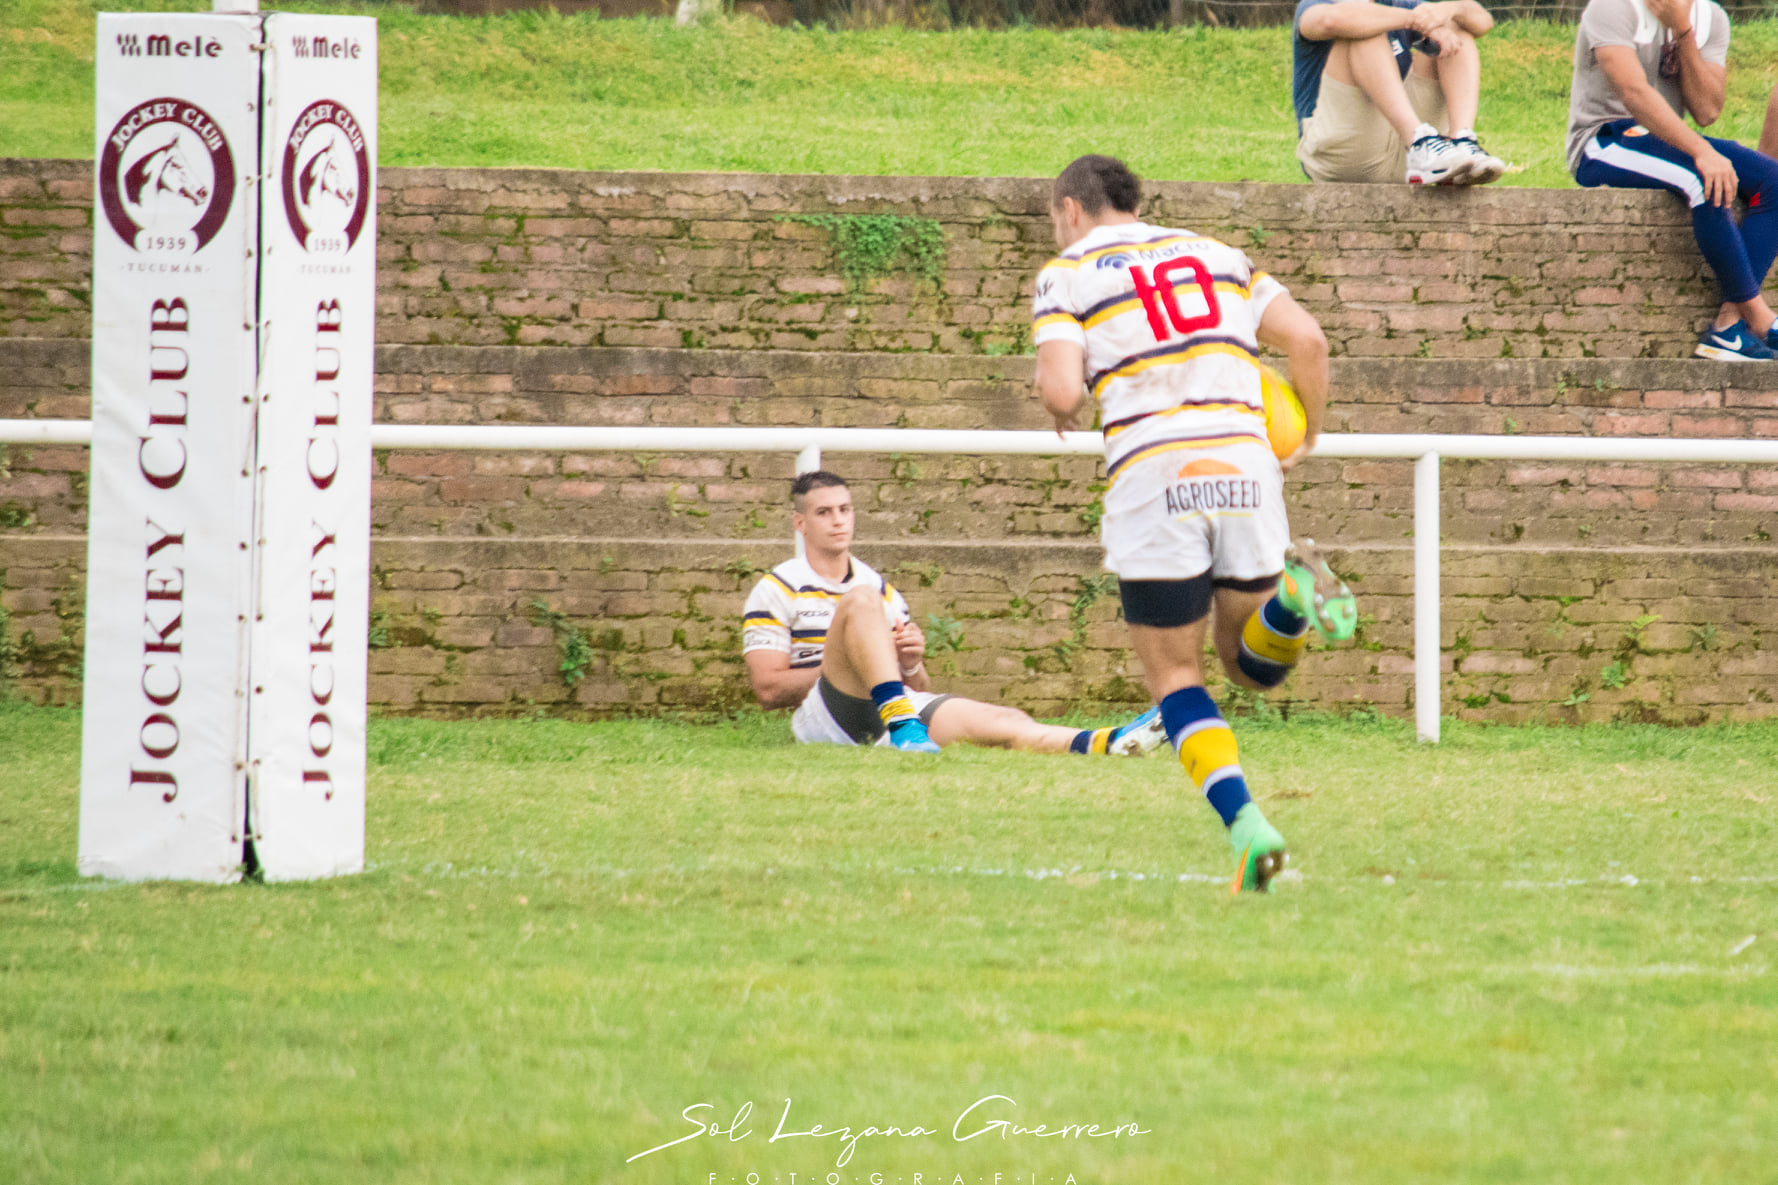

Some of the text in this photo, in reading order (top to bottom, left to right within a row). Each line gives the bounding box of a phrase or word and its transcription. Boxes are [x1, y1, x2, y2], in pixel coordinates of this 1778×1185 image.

[110, 102, 225, 153] JOCKEY CLUB
[289, 104, 364, 154] JOCKEY CLUB
[147, 236, 187, 250] 1939
[314, 237, 342, 251] 1939
[1138, 241, 1210, 262] Macro
[1128, 255, 1222, 342] 10
[1165, 479, 1262, 516] AGROSEED
[128, 296, 190, 804] JOCKEY CLUB
[302, 298, 342, 803] JOCKEY CLUB
